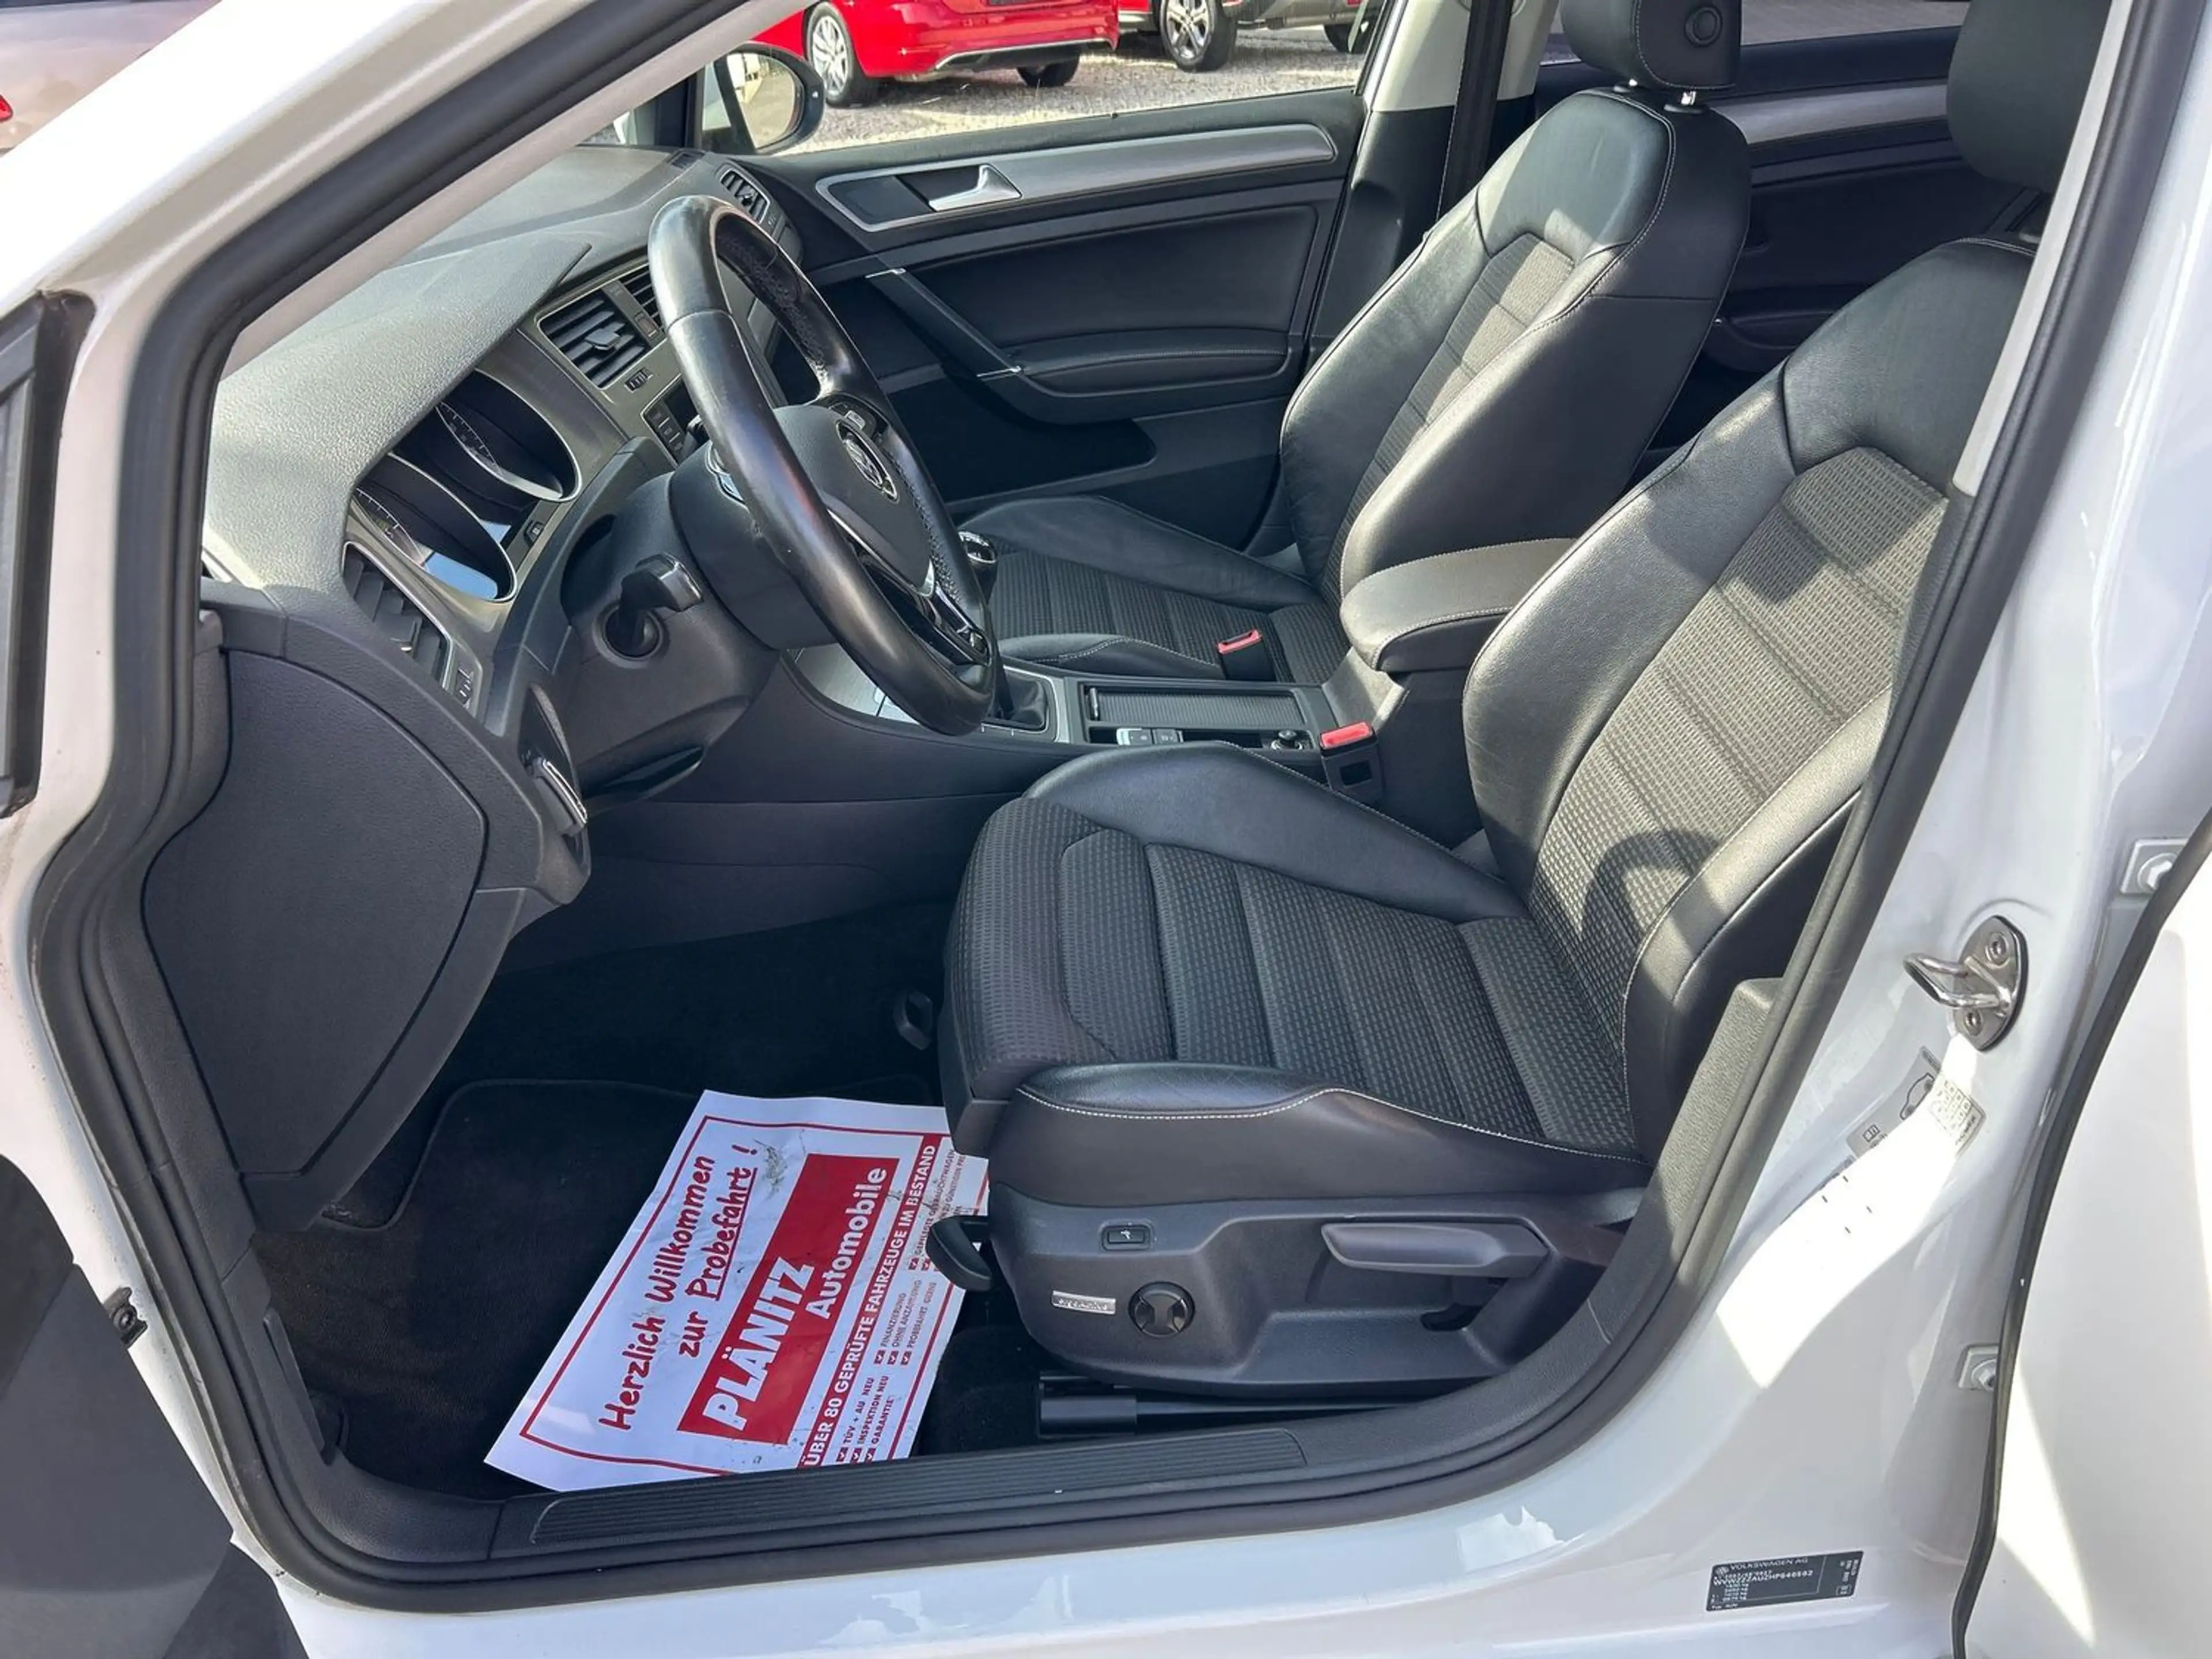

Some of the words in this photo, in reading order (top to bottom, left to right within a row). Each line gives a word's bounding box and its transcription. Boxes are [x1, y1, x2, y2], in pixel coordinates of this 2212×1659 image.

[732, 1144, 757, 1156] !
[906, 1145, 935, 1206] BESTAND
[685, 1166, 752, 1298] Probefahrt
[805, 1168, 887, 1319] Automobile
[898, 1210, 915, 1226] IM
[599, 1317, 666, 1430] Herzlich
[645, 1156, 715, 1302] Willkommen
[865, 1230, 907, 1312] FAHRZEUGE
[679, 1311, 708, 1357] zur
[702, 1256, 815, 1431] PLÄNITZ
[835, 1316, 874, 1393] GEPRÜFTE
[824, 1397, 842, 1418] 80
[843, 1426, 855, 1444] TÜV
[855, 1401, 865, 1414] AU
[862, 1377, 874, 1396] NEU
[857, 1400, 880, 1444] INSPEKTION
[878, 1376, 889, 1399] NEU
[801, 1422, 833, 1465] ÜBER
[1730, 1558, 1794, 1570] VOLKSWAGEN
